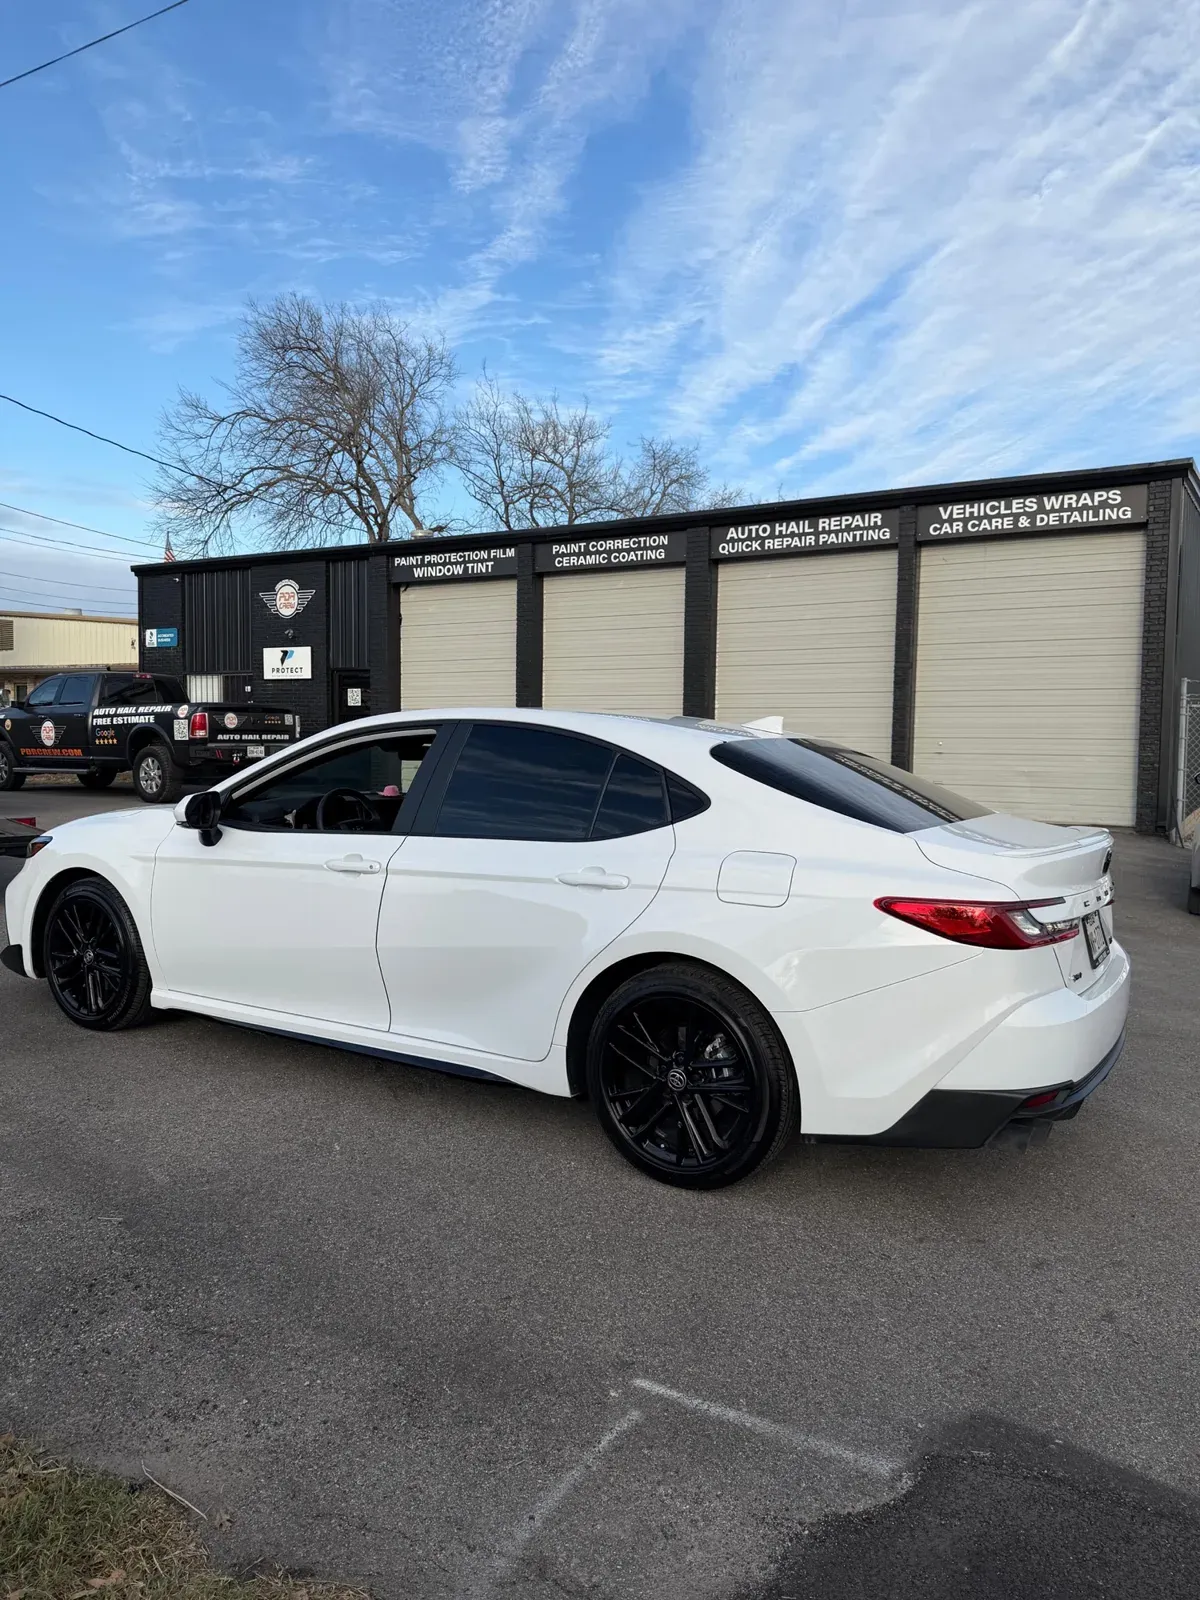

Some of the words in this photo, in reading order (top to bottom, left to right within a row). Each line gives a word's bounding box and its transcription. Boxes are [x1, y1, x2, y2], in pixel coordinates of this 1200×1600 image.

[938, 497, 1038, 520] VEHICLES
[1042, 489, 1122, 511] WRAPS
[726, 524, 771, 540] AUTO
[775, 520, 814, 536] HAIL
[818, 512, 882, 532] REPAIR
[929, 521, 963, 536] CAR
[967, 517, 1014, 532] CARE
[1018, 515, 1031, 528] &
[1036, 506, 1132, 527] DETAILING
[552, 542, 586, 555] PAINT
[588, 535, 668, 552] CORRECTION
[718, 539, 762, 555] QUICK
[764, 535, 816, 550] REPAIR
[818, 528, 891, 545] PAINTING
[394, 555, 422, 567] PAINT
[424, 550, 488, 564] PROTECTION
[490, 547, 515, 558] FILM
[555, 554, 608, 567] CERAMIC
[611, 549, 665, 563] COATING
[413, 564, 464, 578] WINDOW
[466, 561, 494, 574] TINT
[92, 707, 116, 716] AUTO
[116, 705, 137, 715] HAIL
[137, 704, 172, 713] REPAIR
[92, 717, 112, 726] FREE
[112, 715, 155, 725] ESTIMATE
[95, 727, 115, 739] Google
[20, 747, 83, 757] PDRCREW.COM
